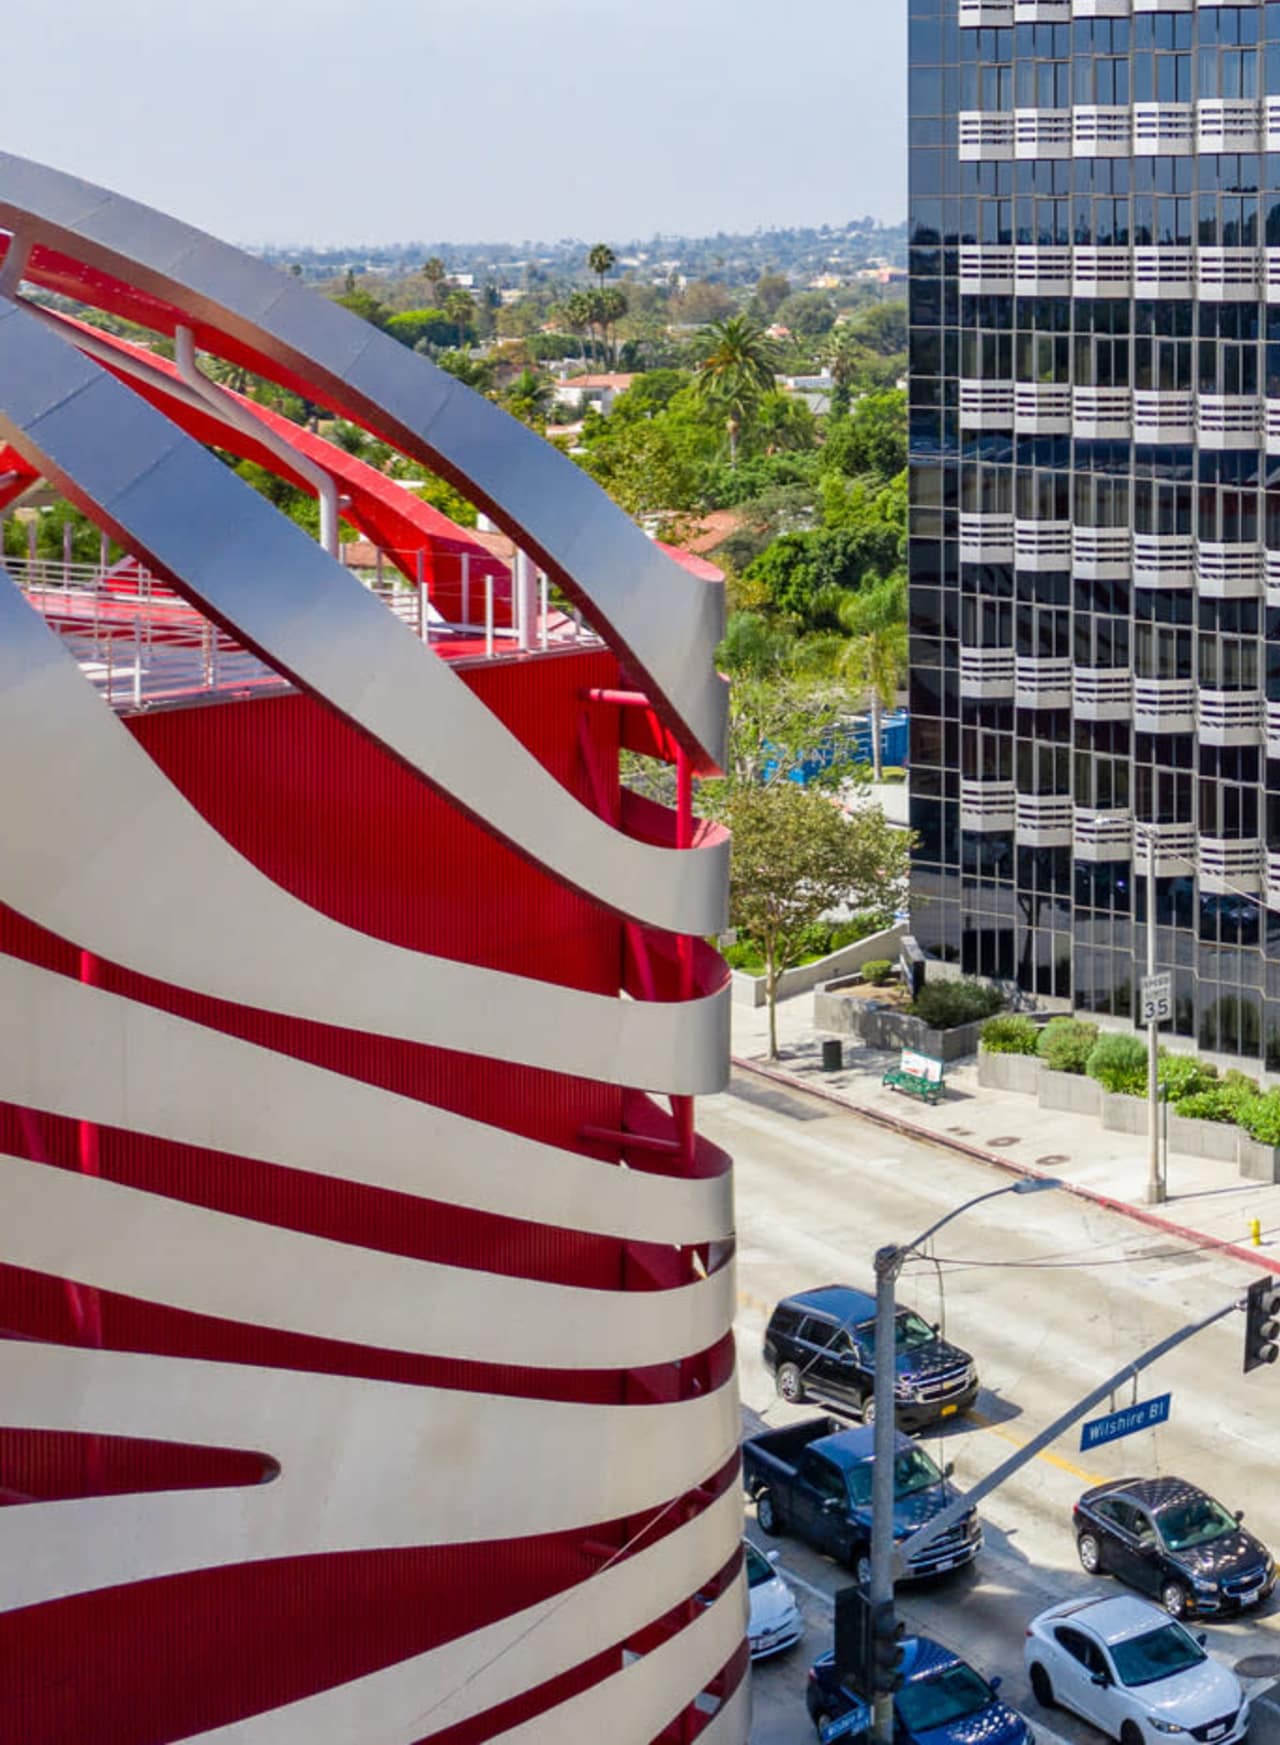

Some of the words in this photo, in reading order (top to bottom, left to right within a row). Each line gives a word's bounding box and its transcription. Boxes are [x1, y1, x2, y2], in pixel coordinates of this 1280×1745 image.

[1145, 998, 1169, 1018] 35
[1089, 1411, 1145, 1441] Wilshire
[1148, 1401, 1164, 1419] Bl
